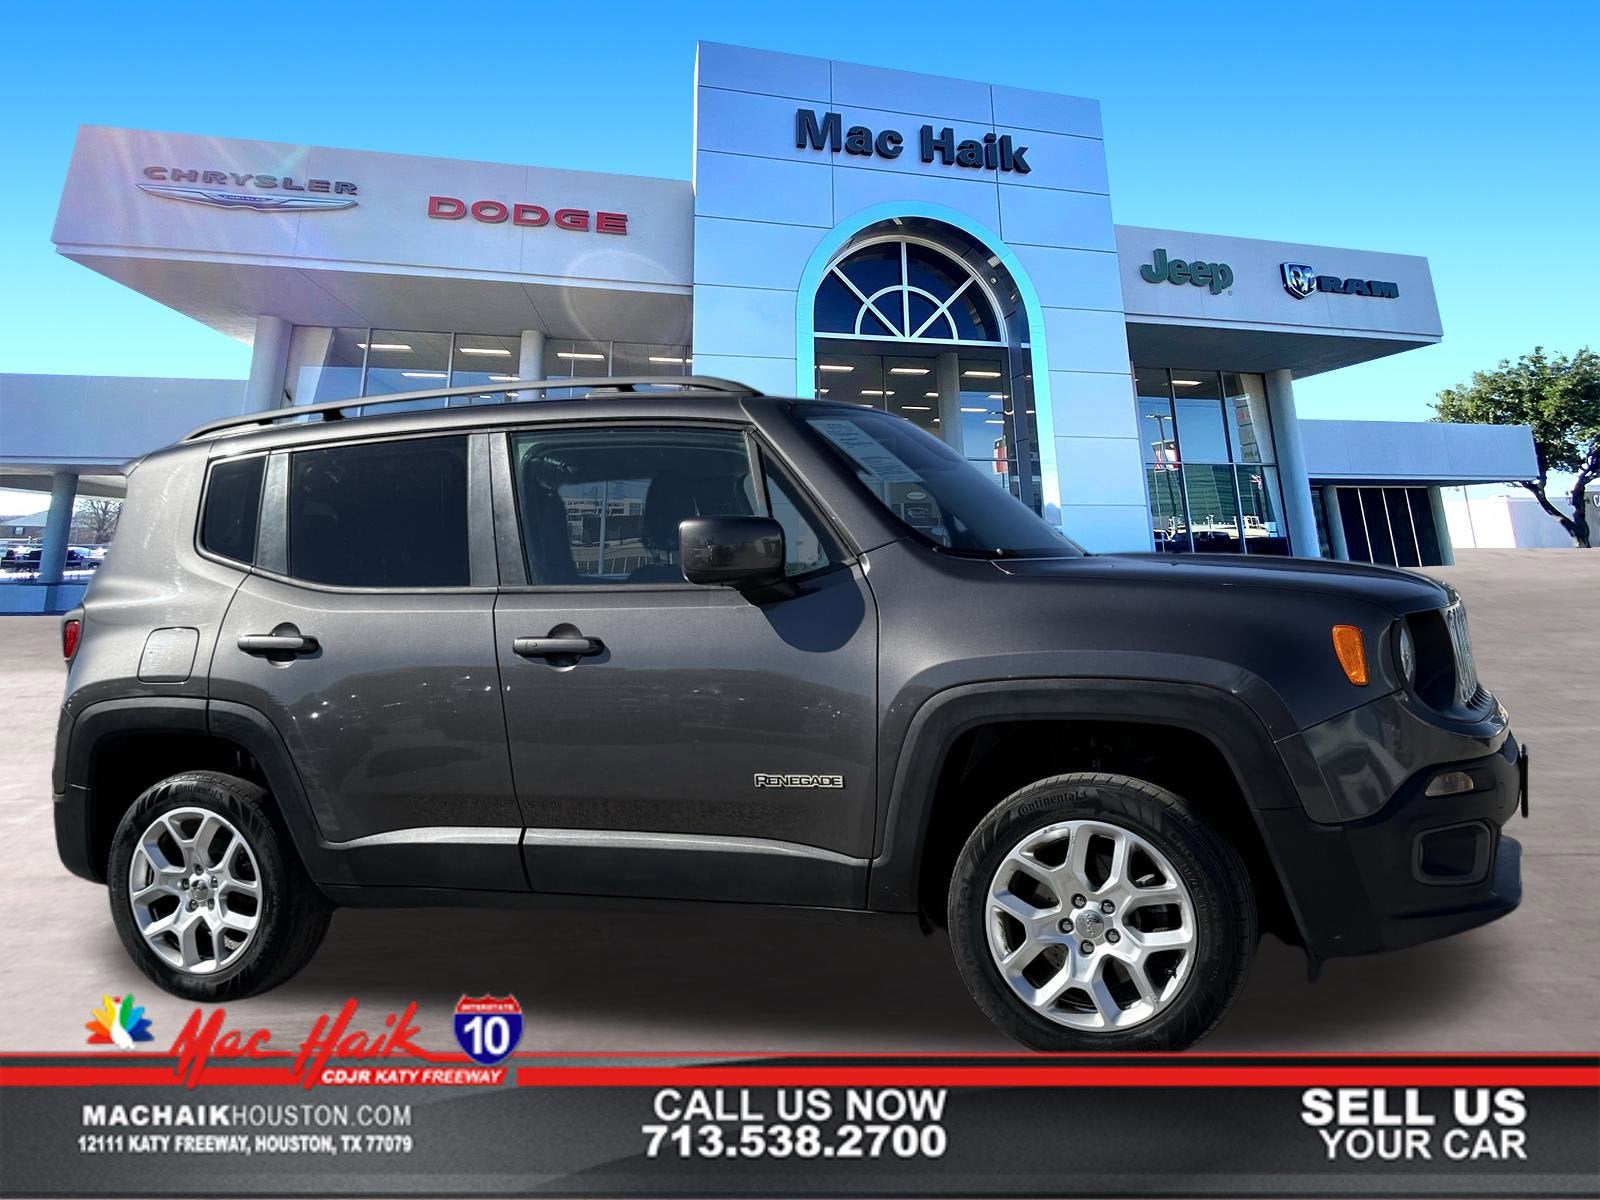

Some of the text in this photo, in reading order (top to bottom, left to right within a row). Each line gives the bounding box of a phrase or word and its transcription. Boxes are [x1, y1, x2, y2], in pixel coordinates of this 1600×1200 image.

[795, 108, 1031, 174] Mac Haik
[142, 165, 359, 196] CHRYSLER
[428, 195, 628, 236] DODGE
[1139, 248, 1234, 295] Jeep
[1315, 275, 1400, 299] RAM
[753, 773, 844, 789] RENEGADE
